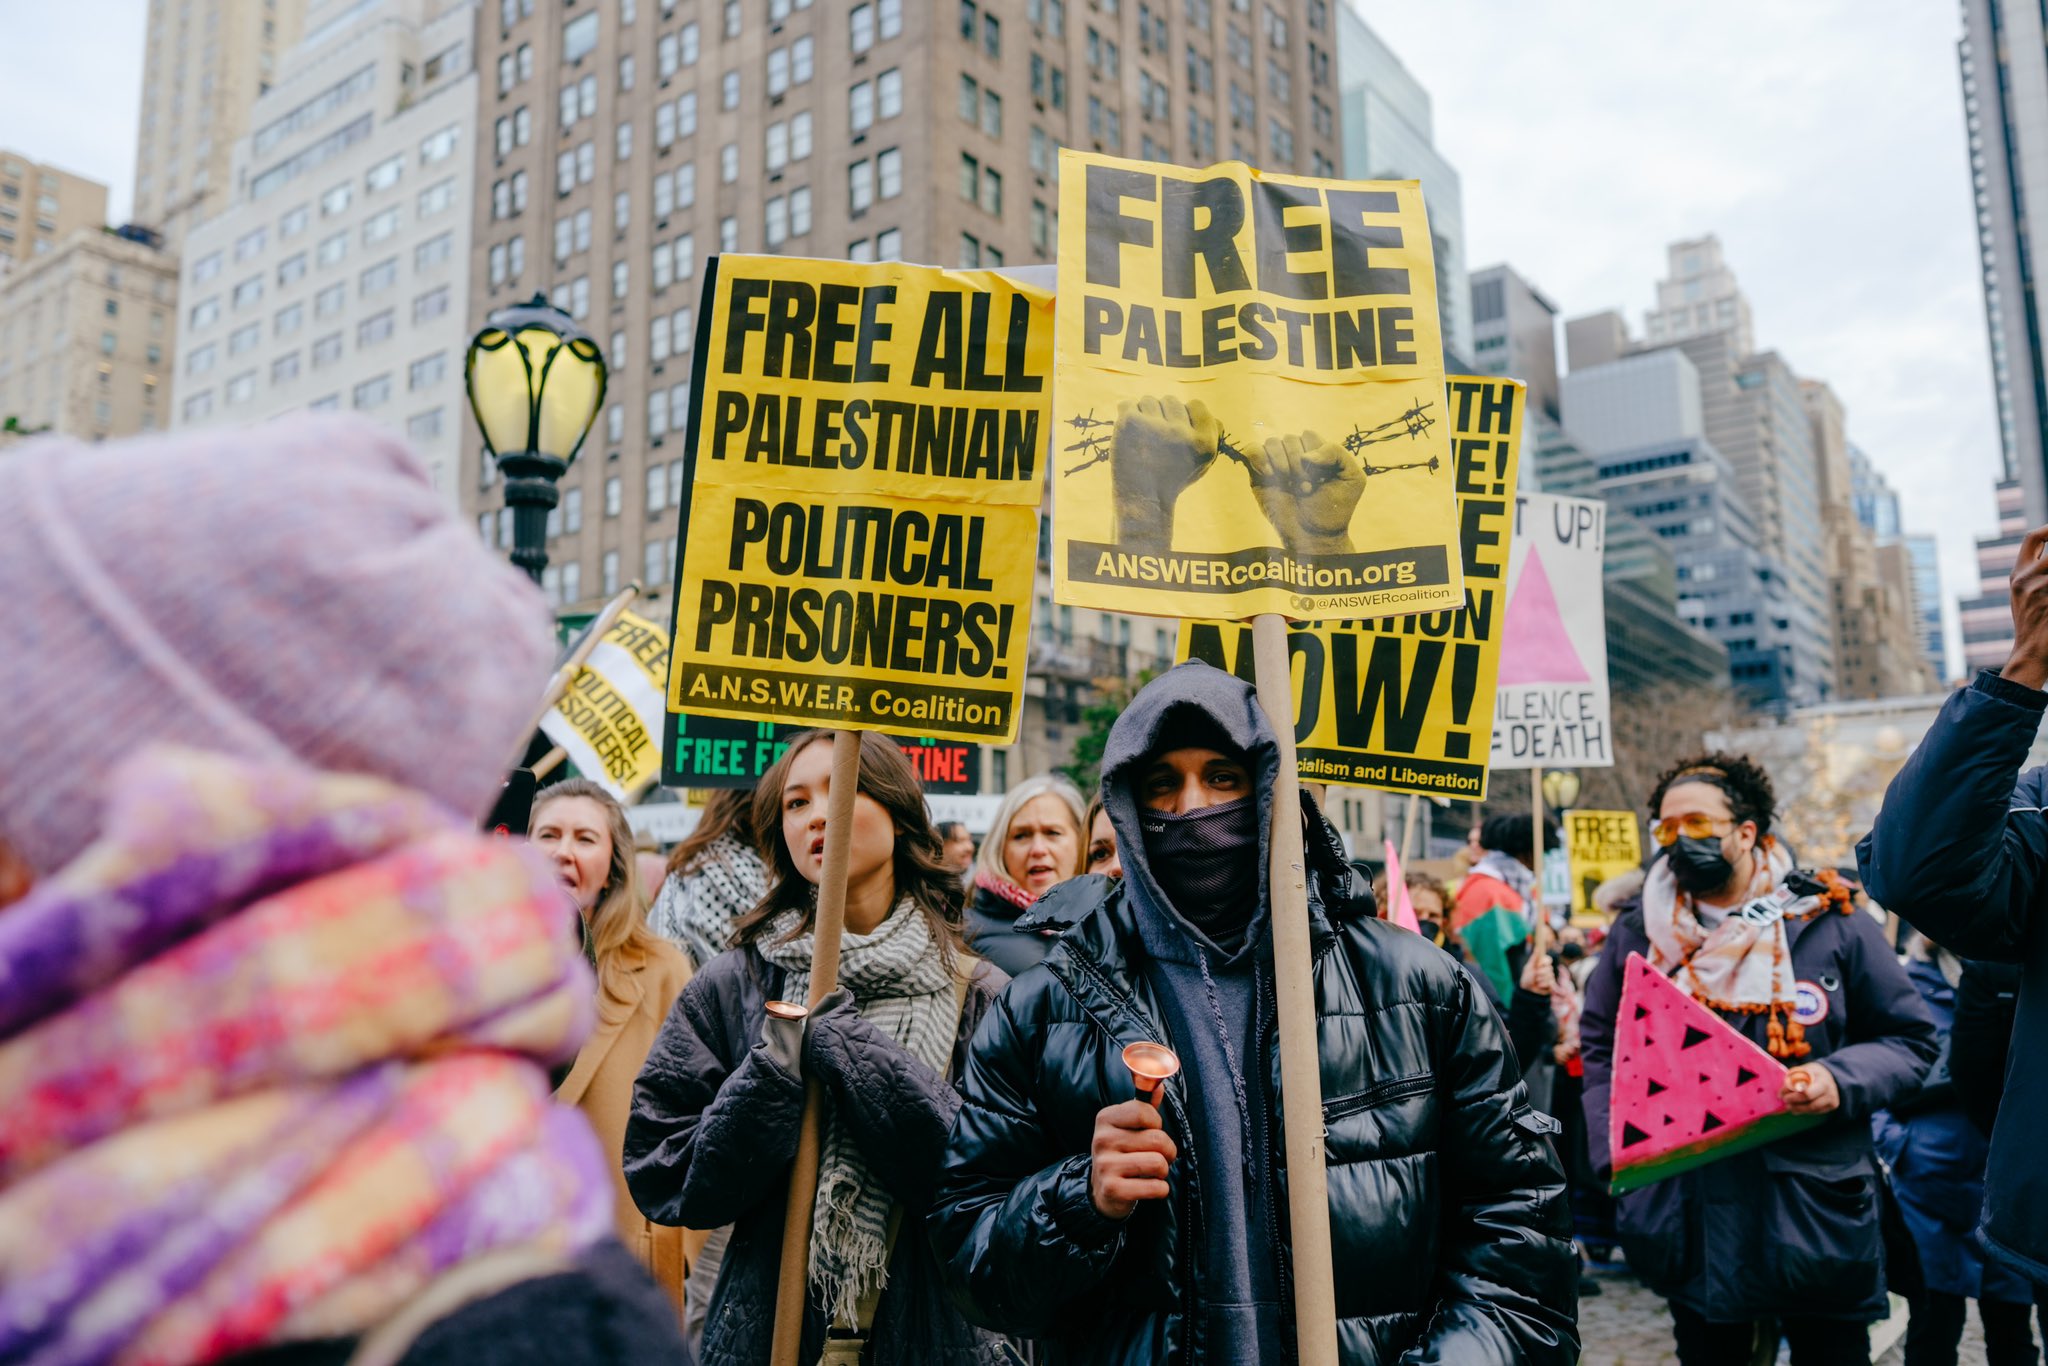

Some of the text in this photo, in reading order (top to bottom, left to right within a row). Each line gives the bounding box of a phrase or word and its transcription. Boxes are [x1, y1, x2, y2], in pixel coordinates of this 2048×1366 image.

[1085, 164, 1412, 300] FREE
[723, 278, 1043, 393] FREE ALL
[1083, 294, 1418, 371] PALESTINE
[712, 390, 1040, 481] PALESTINIAN
[728, 498, 994, 592] POLITICAL
[1554, 502, 1603, 551] UP!
[1095, 551, 1416, 588] ANSWERcoalition.org
[1316, 588, 1450, 610] @ANSWERcoalition
[694, 579, 1015, 680] PRISONERS!
[688, 672, 1001, 726] A.N.S.W.E.R. Coalition
[1497, 690, 1595, 722] ILENCE
[675, 737, 746, 776] FREE
[1511, 720, 1605, 760] DEATH
[1297, 757, 1480, 791] cialism and Liberation
[1573, 816, 1632, 844] FREE
